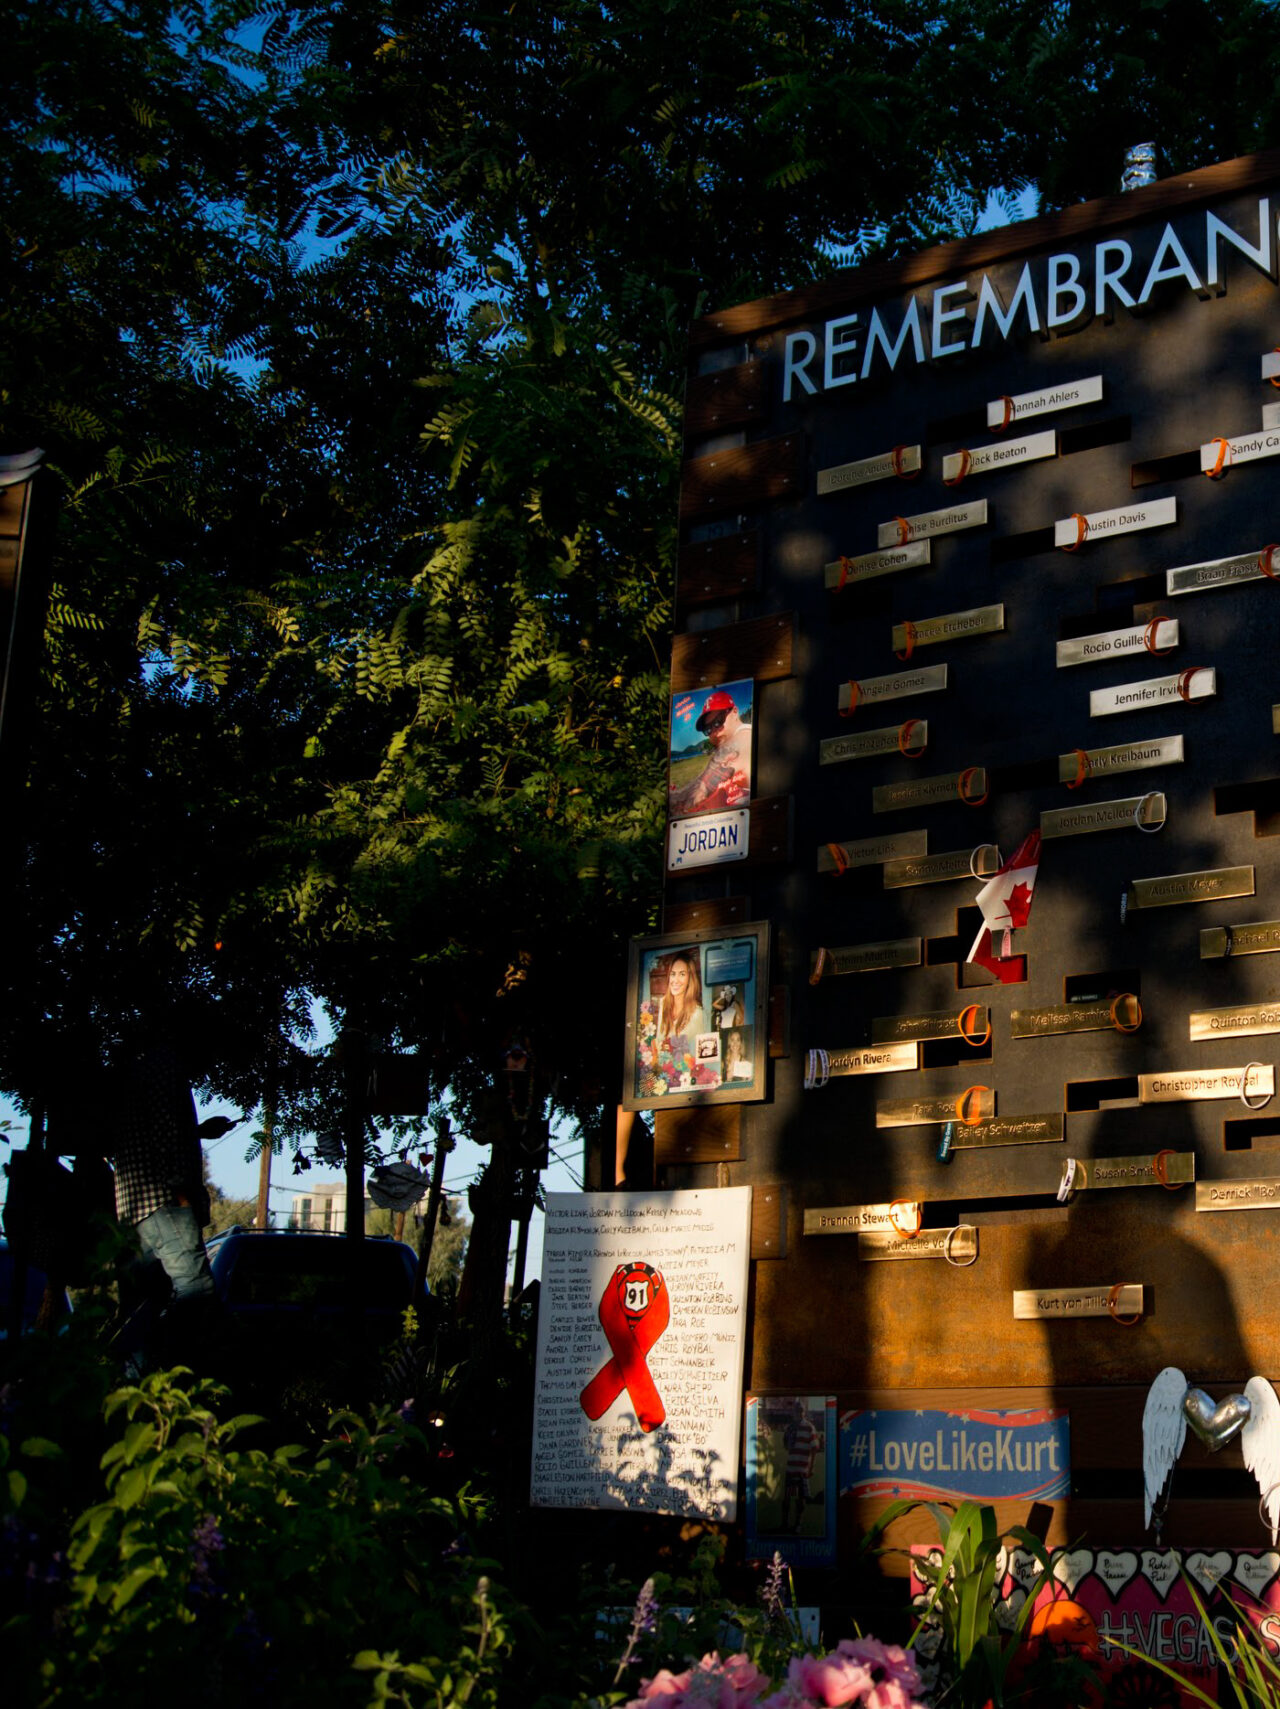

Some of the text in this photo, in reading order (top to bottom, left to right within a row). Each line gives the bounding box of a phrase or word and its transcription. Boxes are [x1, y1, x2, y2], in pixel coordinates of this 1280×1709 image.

[1048, 388, 1080, 406] Ahlers
[970, 444, 1027, 467] Jack Beaton
[1231, 439, 1264, 457] Sandy
[896, 510, 968, 538] Dnise Burditus
[1085, 510, 1146, 533] Austin Davis
[879, 552, 907, 569] Cohen
[1197, 569, 1226, 583] Brian
[1083, 633, 1150, 656] Rocio Guillen
[892, 676, 925, 691] Gomez
[1114, 688, 1157, 705] Jennifer
[1110, 747, 1161, 764] Kreibaum
[679, 824, 738, 854] JORDAN
[1210, 1012, 1256, 1029] Quinton
[828, 1056, 861, 1071] Jordyn
[863, 1053, 891, 1066] Rivera
[1152, 1077, 1218, 1093] Christopher
[1095, 1166, 1127, 1179] Susan
[1210, 1187, 1251, 1201] Derrick
[1254, 1185, 1280, 1198] "Bo"
[628, 1288, 644, 1304] 91
[1037, 1296, 1060, 1310] Kurt
[1062, 1298, 1082, 1310] von
[849, 1429, 1061, 1473] #LoveLikeKurt
[1097, 1610, 1240, 1666] #VEGAS
